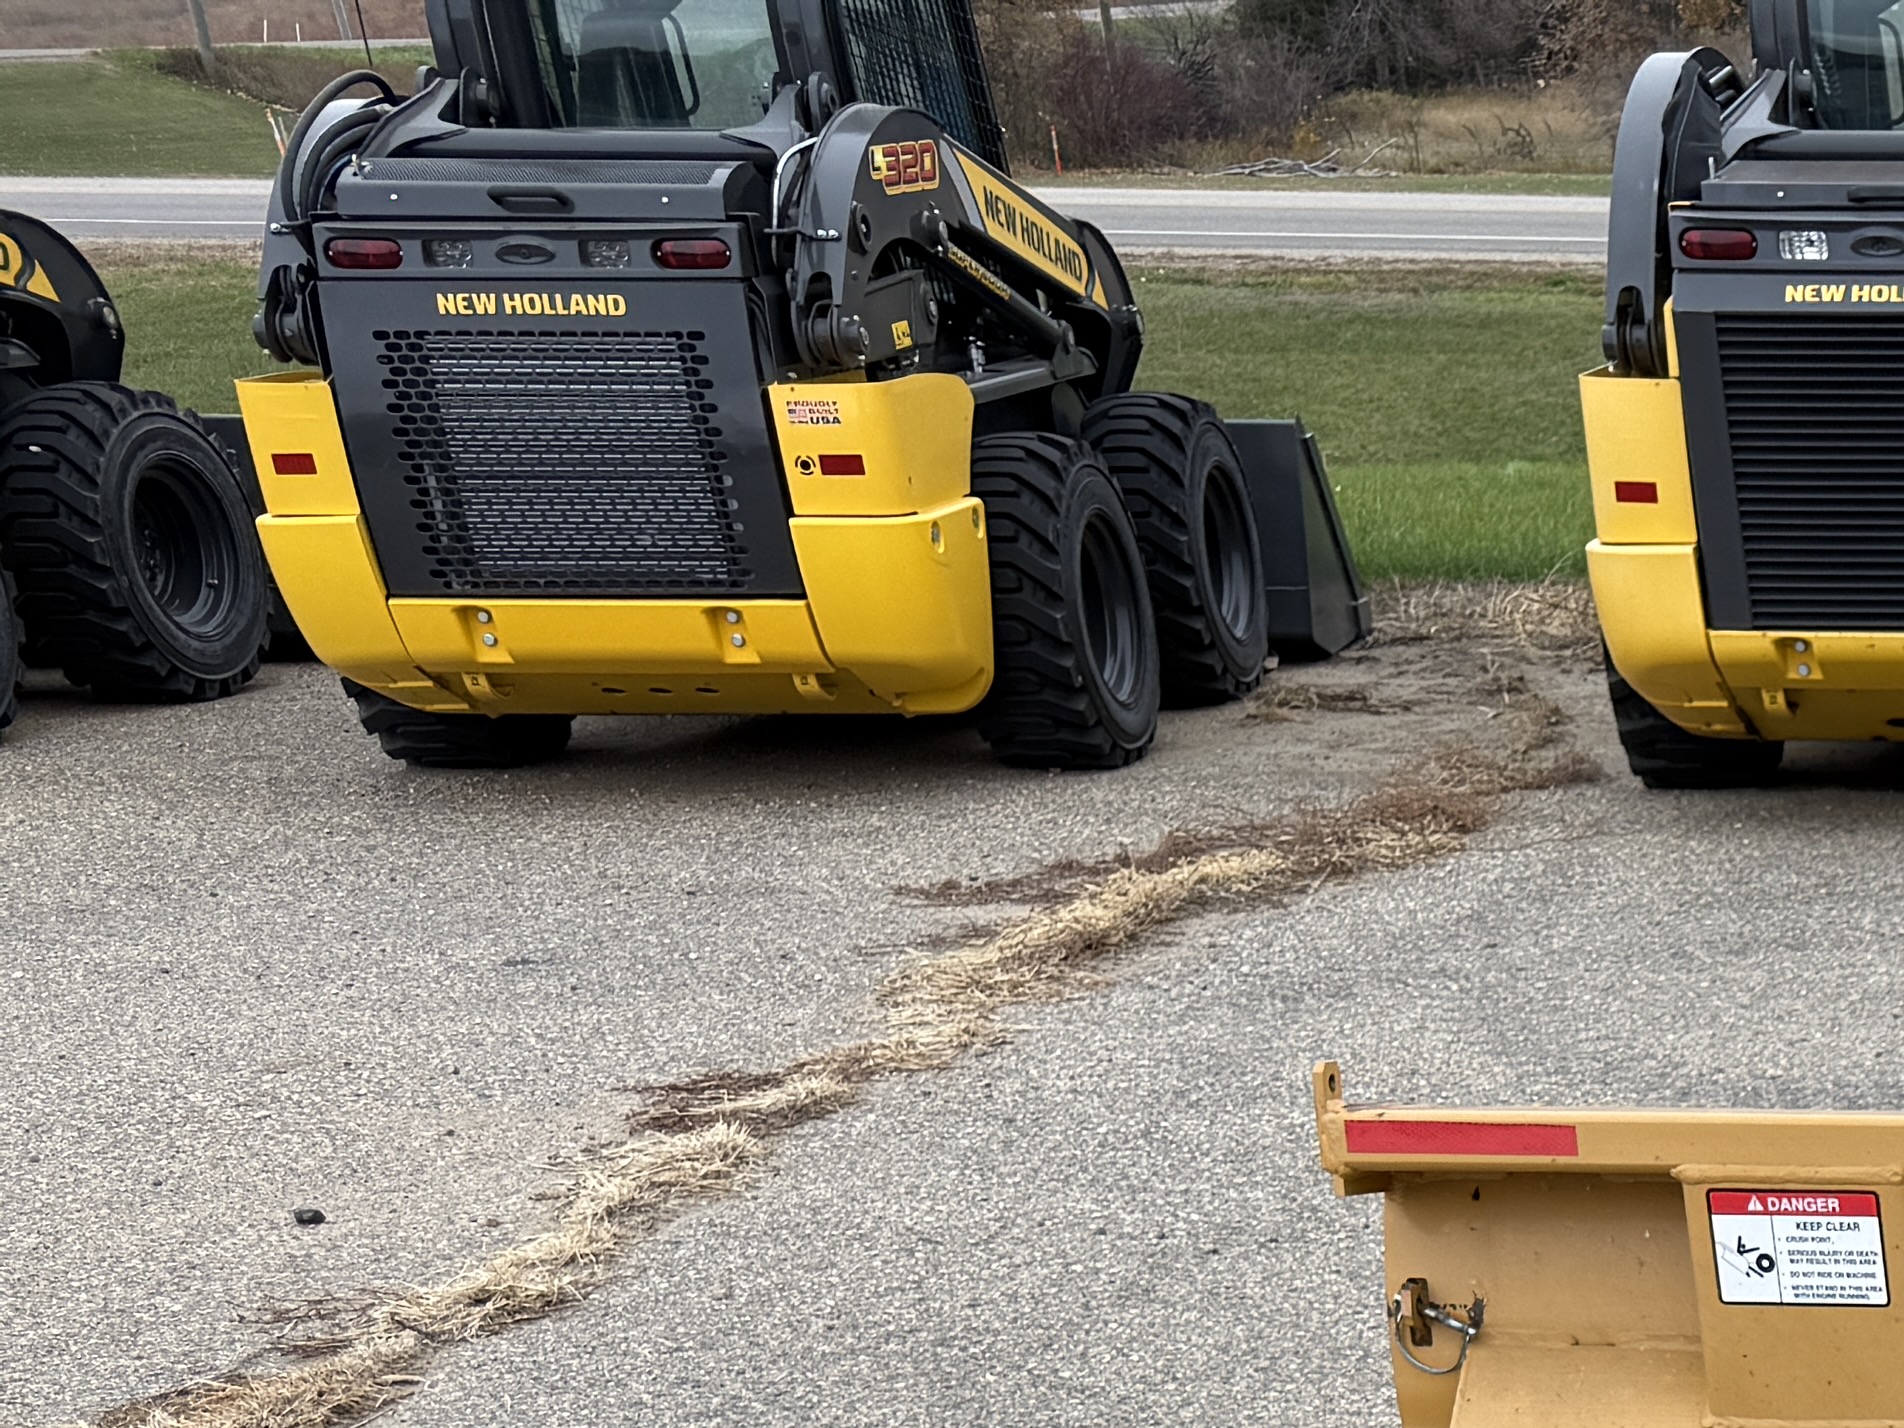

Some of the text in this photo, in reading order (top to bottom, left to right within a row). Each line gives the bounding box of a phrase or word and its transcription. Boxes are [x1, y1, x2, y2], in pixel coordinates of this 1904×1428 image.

[983, 185, 1083, 283] NEW HOLLAND
[1785, 284, 1846, 303] NEW
[436, 293, 627, 317] NEW HOLLAND
[809, 416, 842, 425] USA
[1767, 1197, 1840, 1213] DANGER
[1796, 1221, 1860, 1232] KEEP CLEAR
[1787, 1249, 1818, 1257] SERIOUS
